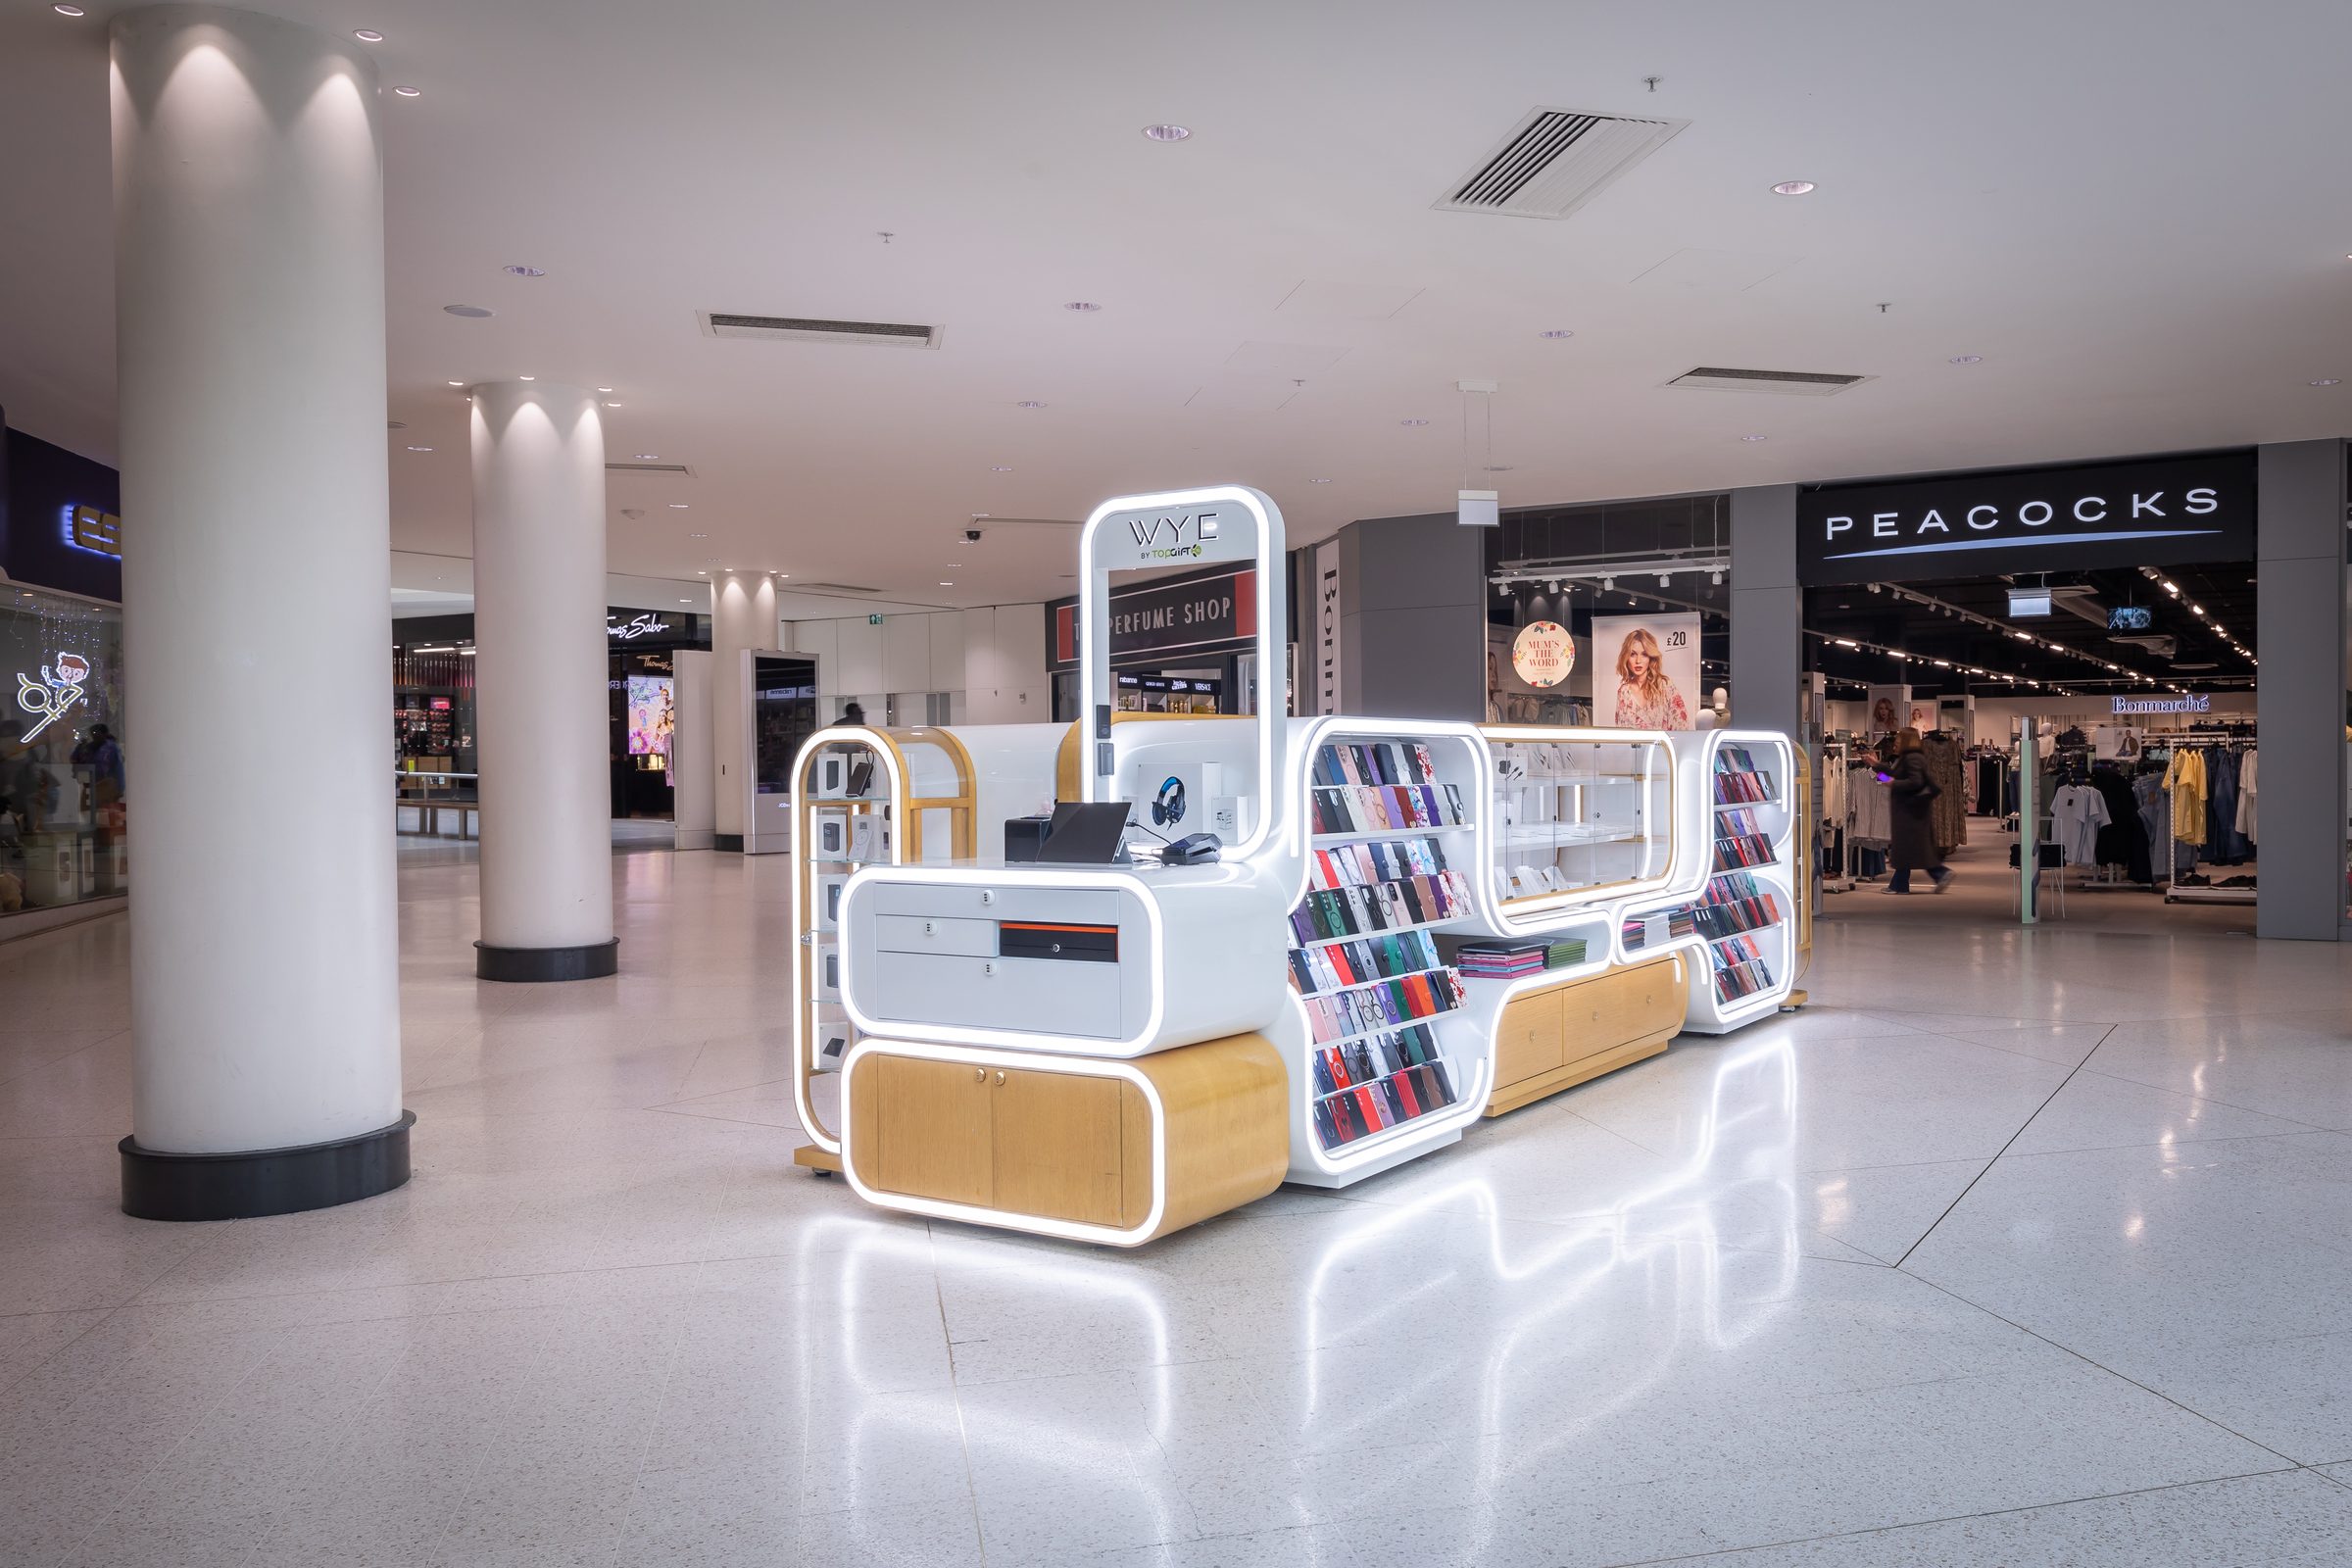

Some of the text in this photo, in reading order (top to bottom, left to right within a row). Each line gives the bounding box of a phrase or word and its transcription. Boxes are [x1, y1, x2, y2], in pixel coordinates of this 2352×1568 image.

[1826, 487, 2219, 541] PEACOCKS
[1129, 513, 1219, 547] WYE
[1184, 597, 1231, 624] SHOP
[625, 613, 669, 639] Sabo
[1529, 640, 1560, 650] MUM'S
[1667, 631, 1687, 646] £20
[1529, 659, 1559, 667] WORD
[1536, 649, 1553, 659] THE
[2111, 695, 2210, 713] Bonmarché
